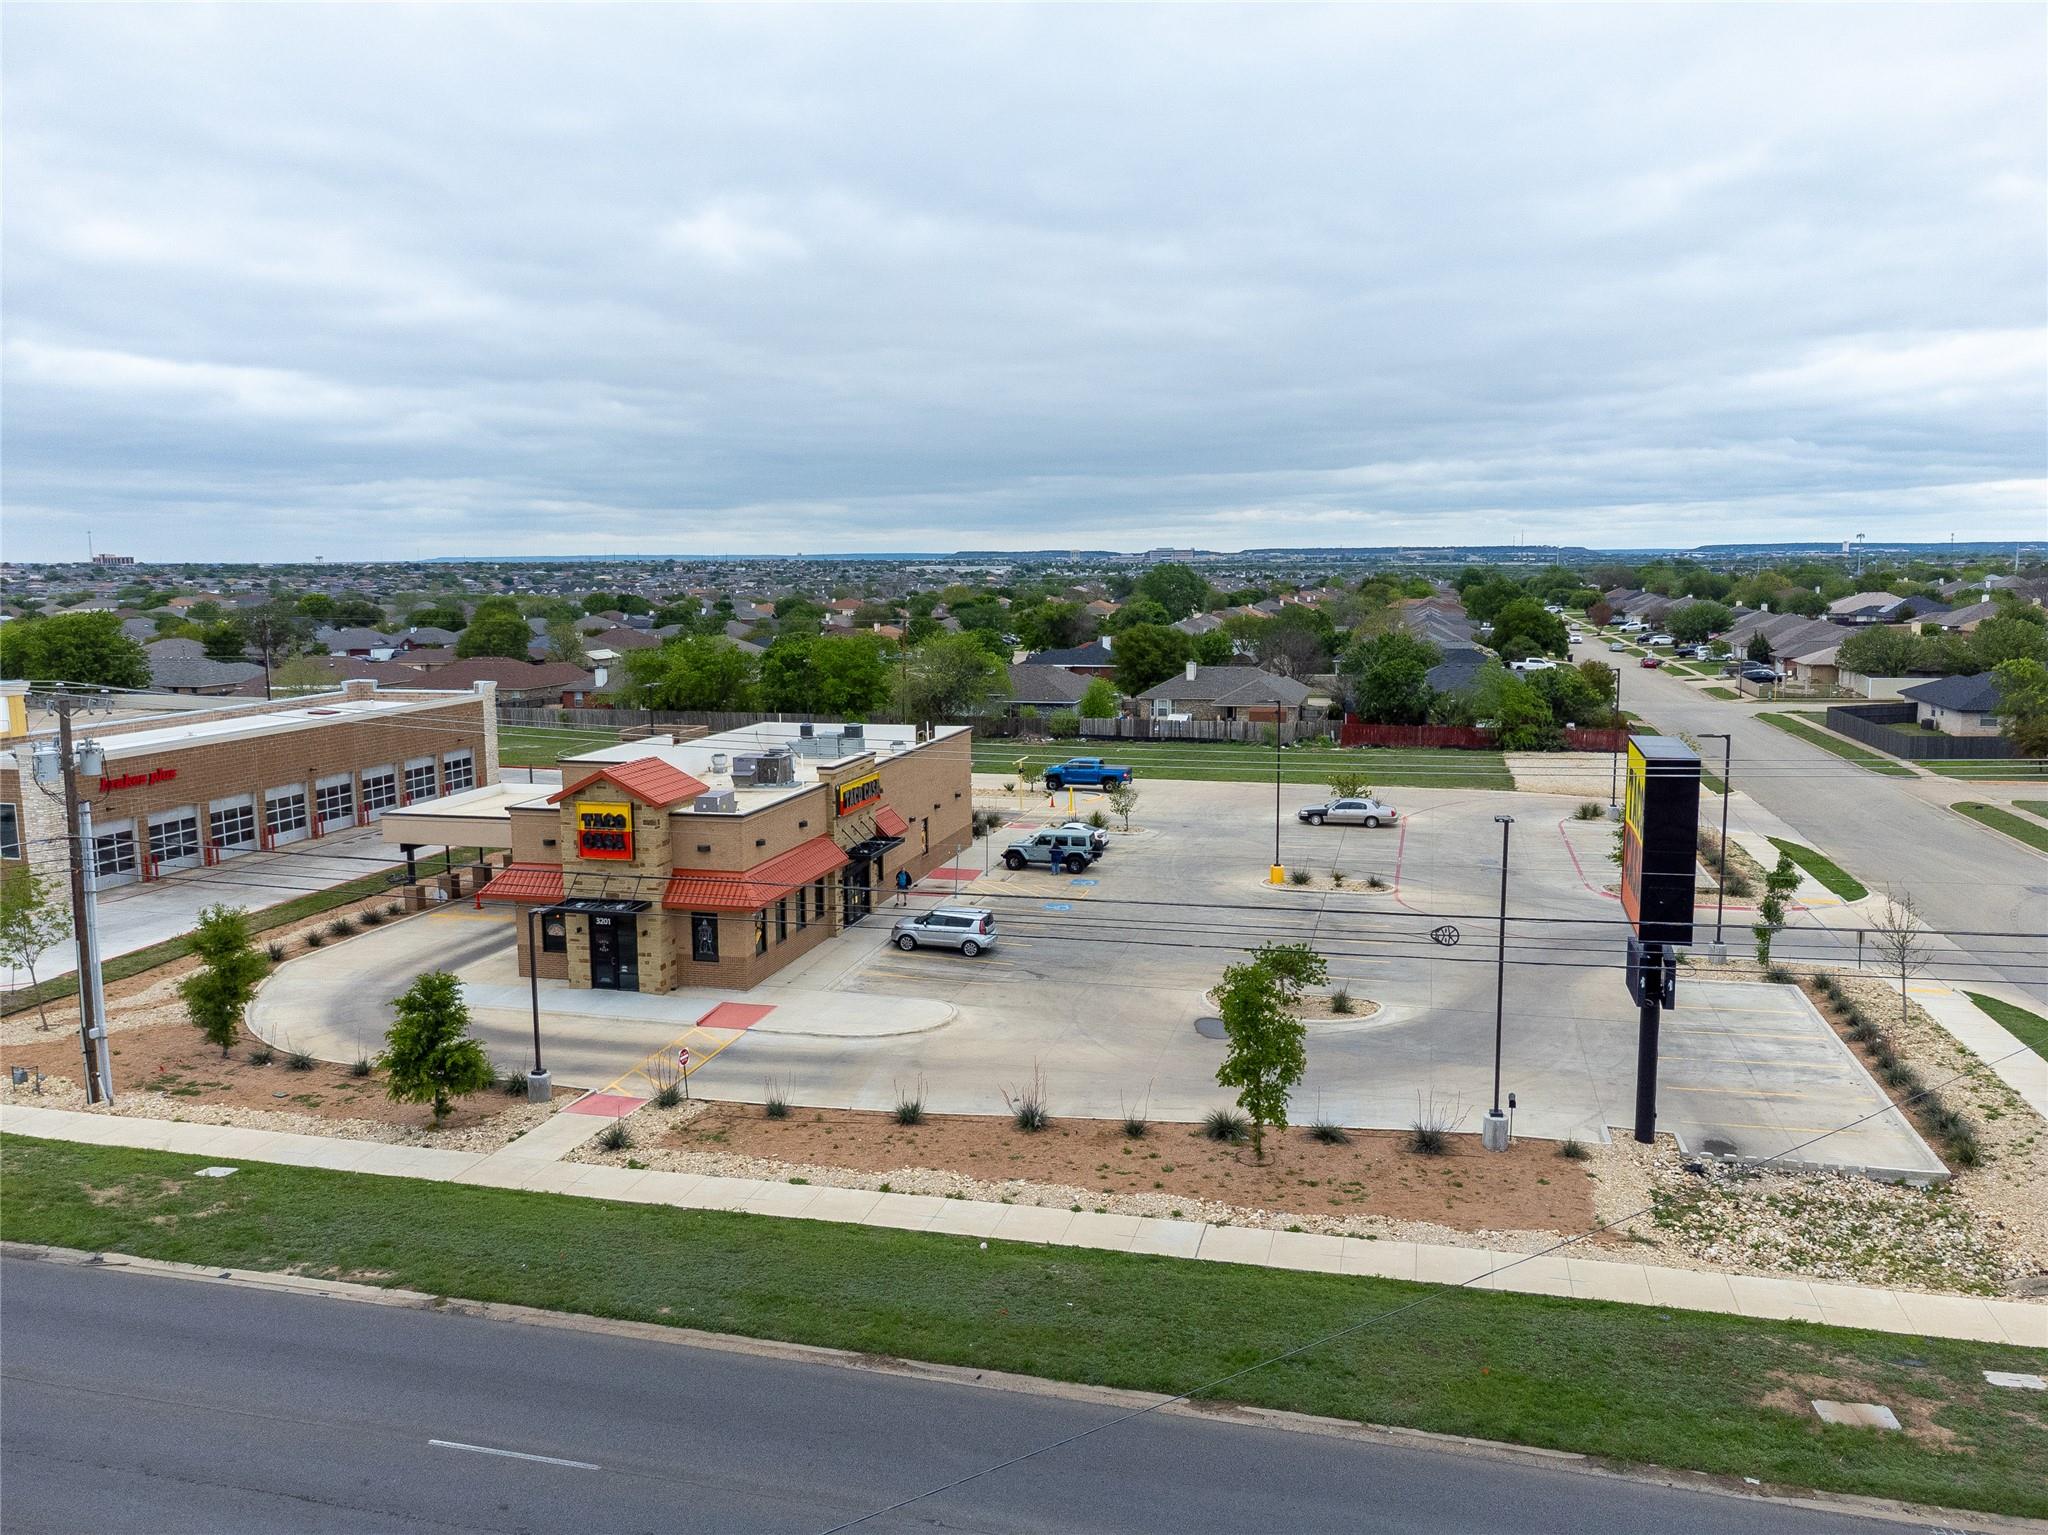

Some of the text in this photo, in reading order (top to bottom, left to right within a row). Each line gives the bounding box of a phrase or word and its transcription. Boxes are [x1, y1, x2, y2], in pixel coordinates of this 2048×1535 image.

[148, 768, 177, 785] plus
[843, 779, 880, 809] TACO CASA
[581, 813, 626, 829] TACO
[583, 832, 625, 849] CASA
[596, 917, 611, 925] 3201
